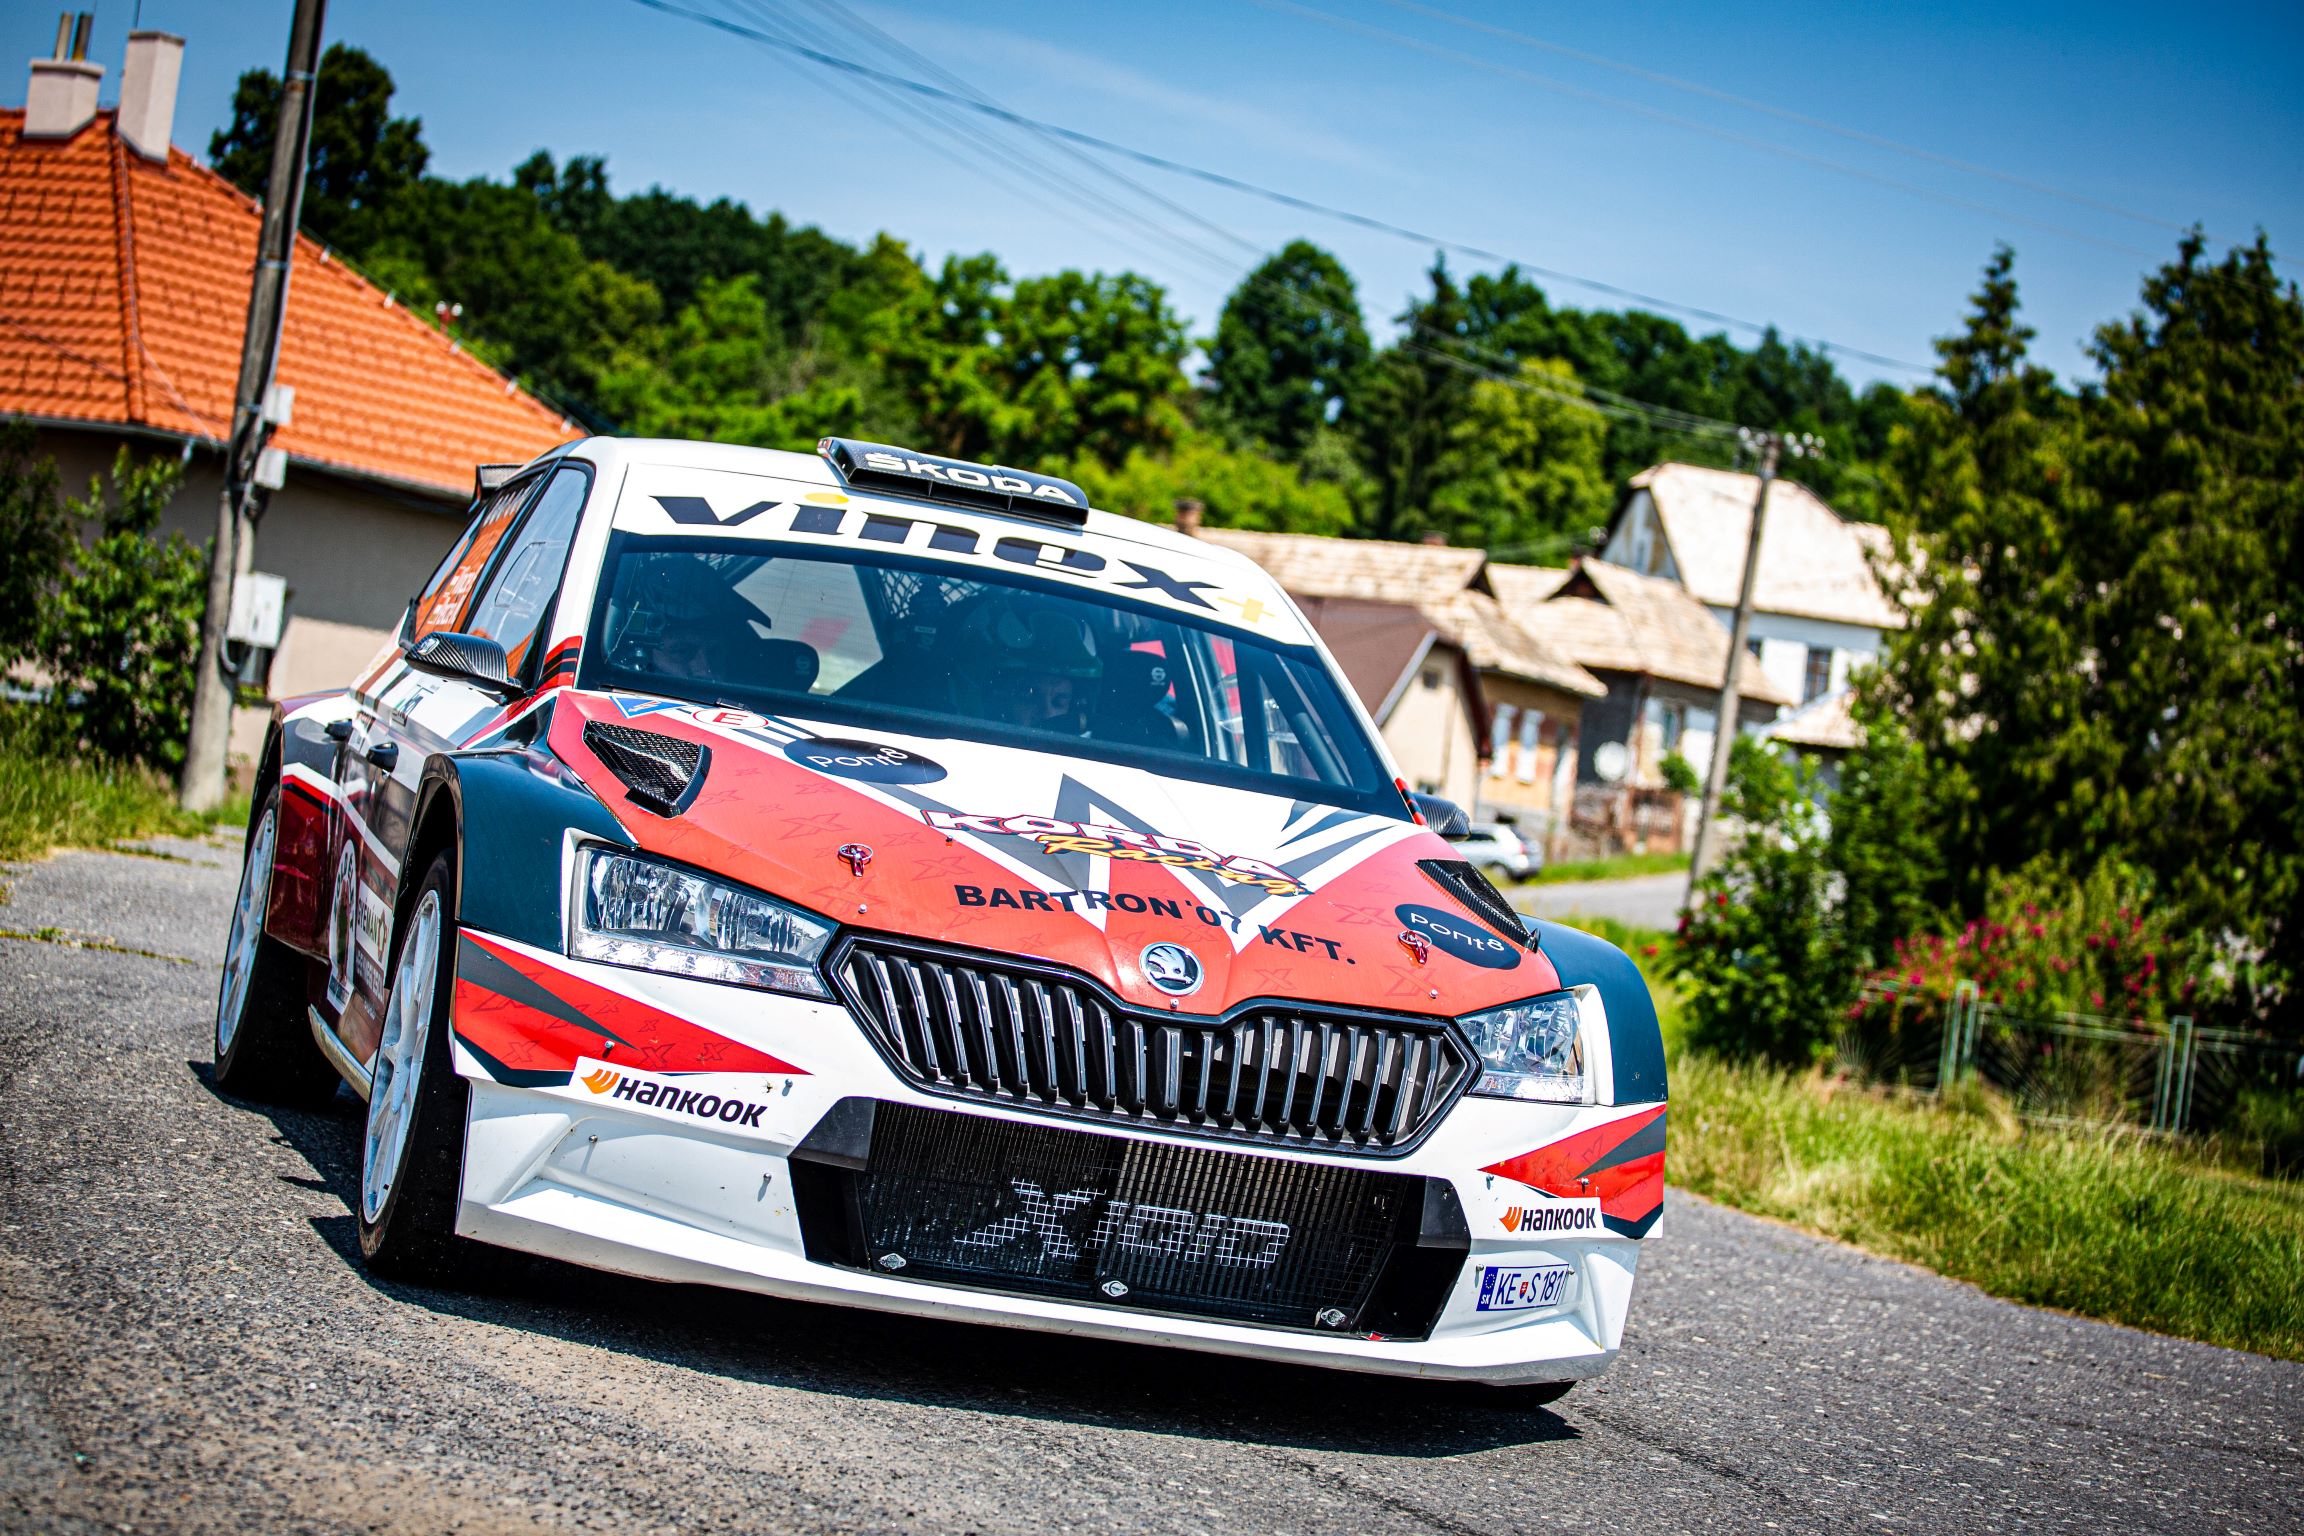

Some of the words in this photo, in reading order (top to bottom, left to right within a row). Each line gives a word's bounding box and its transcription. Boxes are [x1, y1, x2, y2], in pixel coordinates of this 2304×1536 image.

[920, 809, 1306, 887] KORDA
[1257, 924, 1356, 965] KFT.
[1494, 1273, 1522, 1305] KE
